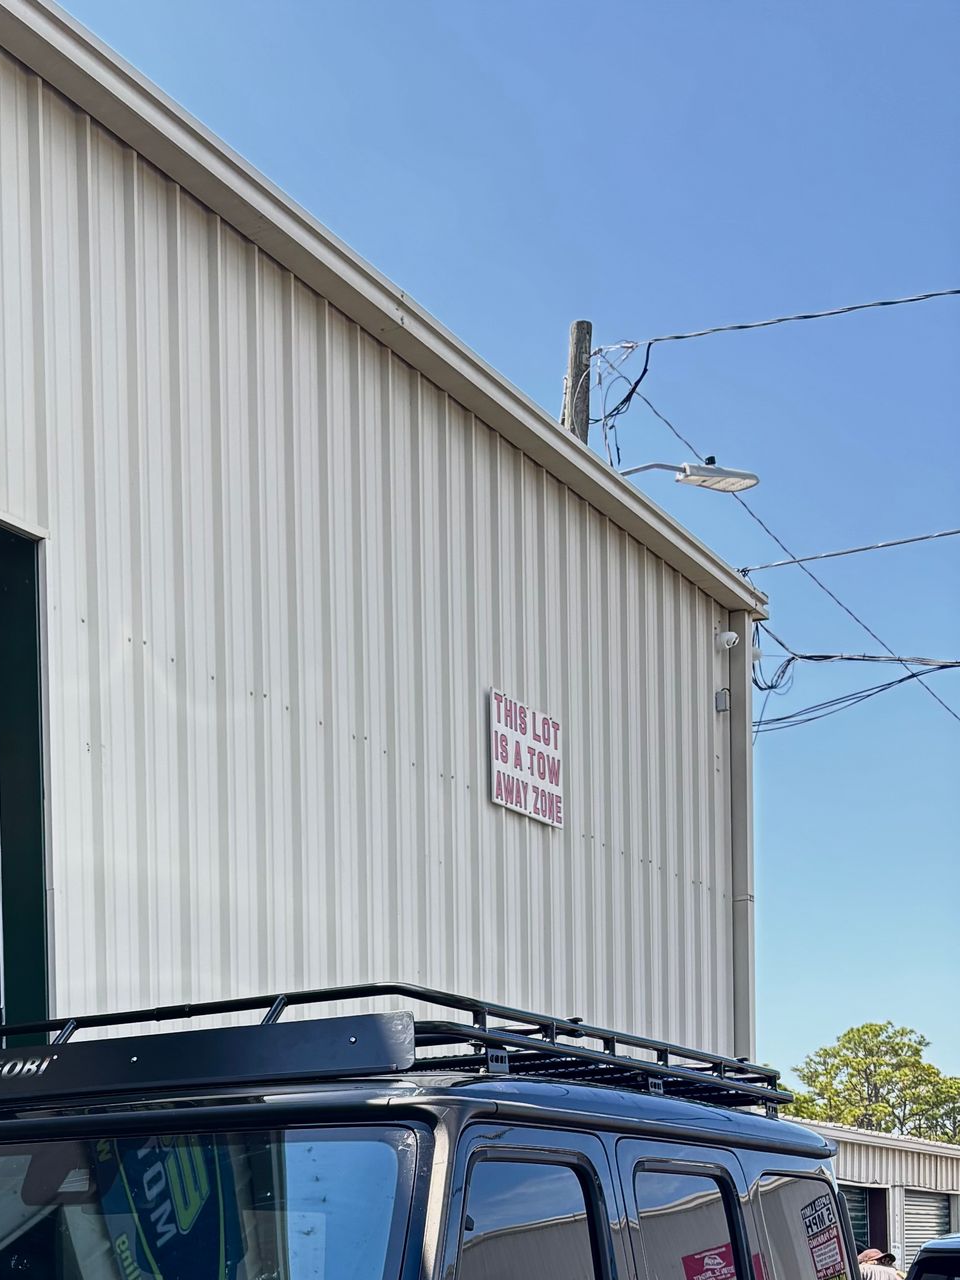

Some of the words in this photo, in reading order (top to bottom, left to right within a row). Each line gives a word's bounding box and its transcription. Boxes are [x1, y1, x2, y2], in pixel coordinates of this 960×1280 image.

[494, 692, 527, 736] THIS
[532, 711, 560, 750] LOT
[494, 730, 509, 764] IS
[514, 740, 523, 771] A
[527, 746, 561, 786] TOW
[495, 770, 528, 810] AWAY
[532, 785, 562, 824] ZONE
